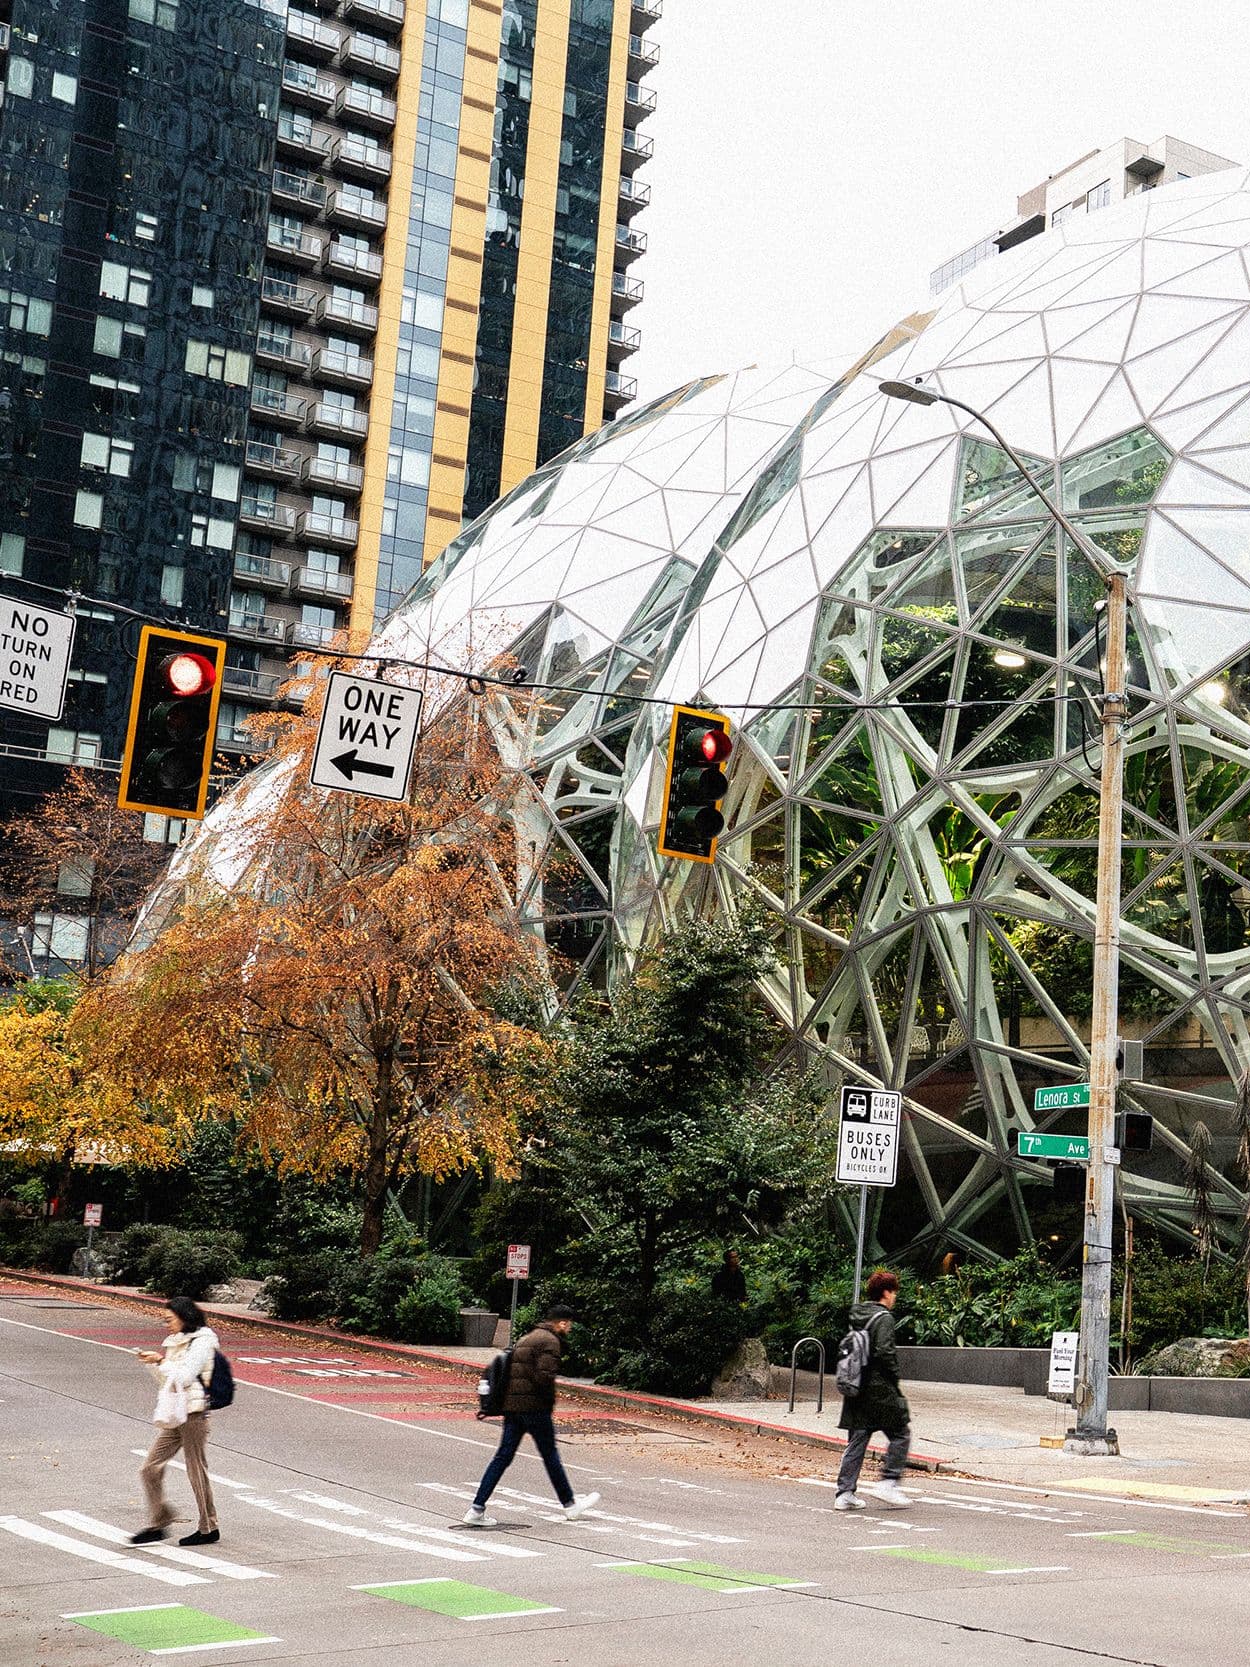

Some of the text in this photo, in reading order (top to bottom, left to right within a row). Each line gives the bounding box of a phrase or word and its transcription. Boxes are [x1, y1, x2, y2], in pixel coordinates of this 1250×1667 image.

[11, 610, 48, 637] NO
[1, 633, 52, 661] TURN
[9, 660, 36, 680] ON
[0, 680, 38, 704] RED
[344, 686, 404, 720] ONE
[339, 716, 401, 749] WAY
[873, 1096, 896, 1108] CURB
[1038, 1091, 1068, 1107] Lenora
[873, 1109, 895, 1121] LANE
[847, 1130, 891, 1147] BUSES
[1023, 1136, 1085, 1154] 7th Ave
[851, 1146, 885, 1161] ONLY
[846, 1162, 876, 1173] BICYCLES
